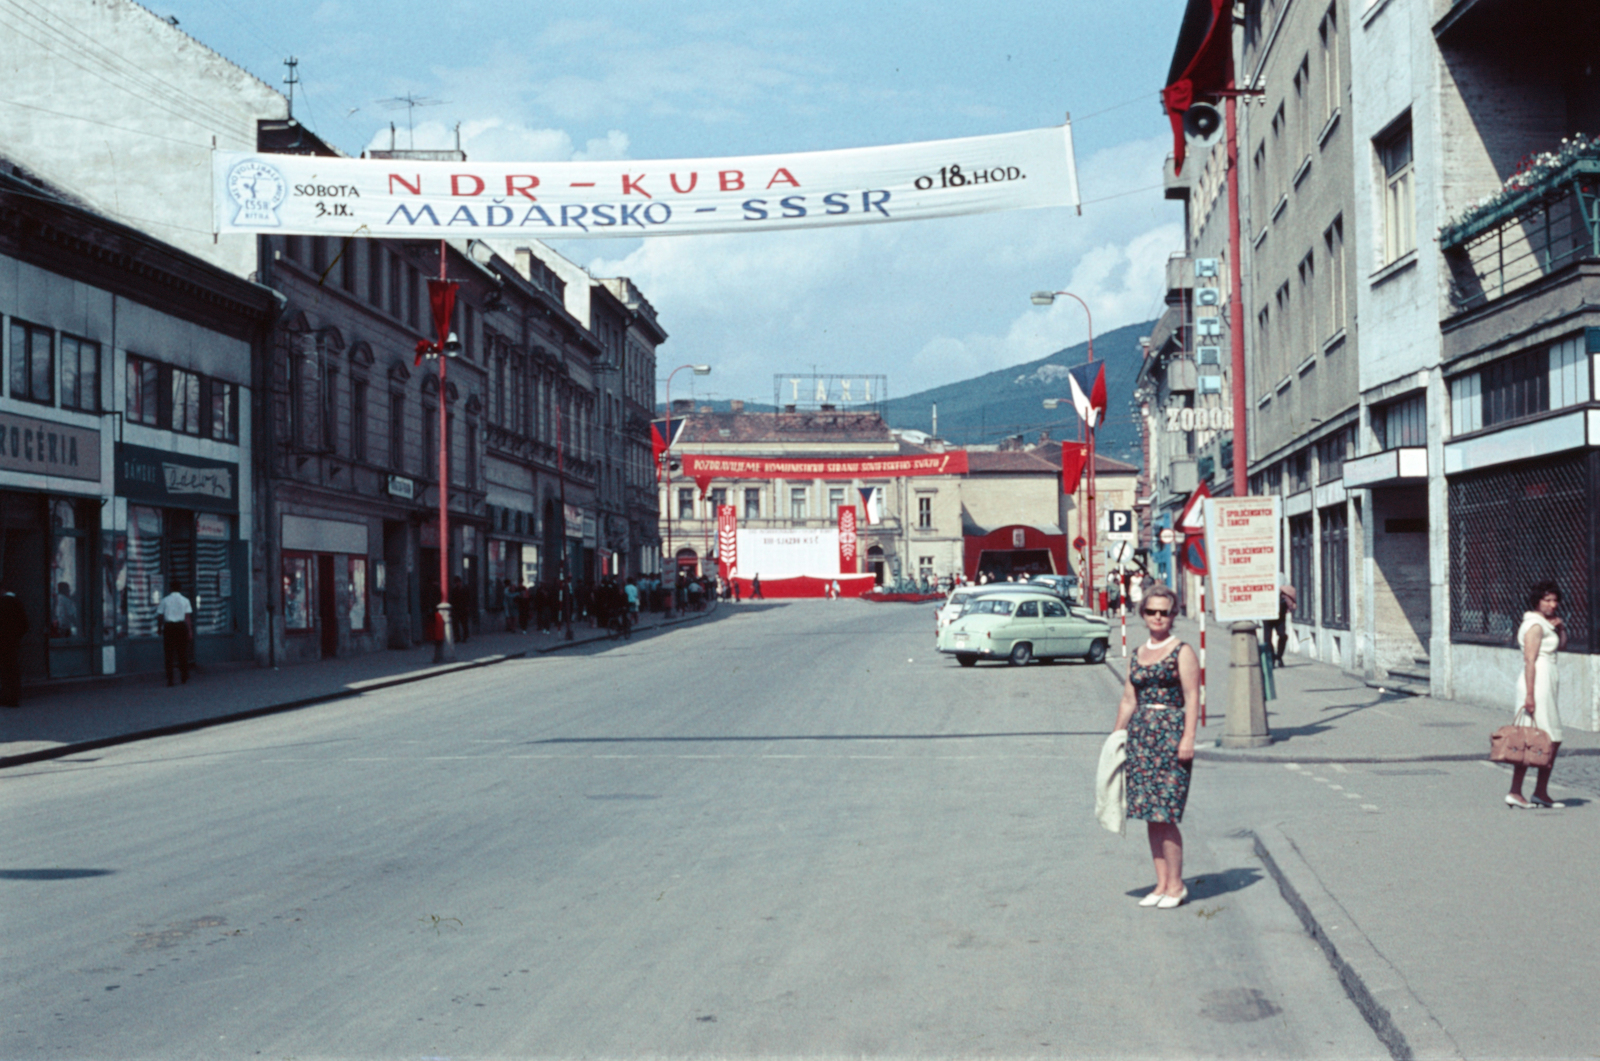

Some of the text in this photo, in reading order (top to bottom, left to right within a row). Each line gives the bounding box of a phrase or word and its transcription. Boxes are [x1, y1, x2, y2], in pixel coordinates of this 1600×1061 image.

[294, 183, 360, 198] SOBOTA
[388, 173, 541, 201] NDR
[622, 167, 801, 199] KUBA
[315, 201, 354, 218] 3.IX.
[386, 198, 672, 233] MAĎARSKO
[742, 189, 892, 221] SSSR
[1196, 259, 1221, 395] HOTEL
[789, 378, 871, 402] TAXI
[1113, 512, 1127, 531] P
[1227, 518, 1250, 527] TANCOV
[1229, 556, 1251, 565] TANCOV
[1229, 593, 1252, 603] TANCOV
